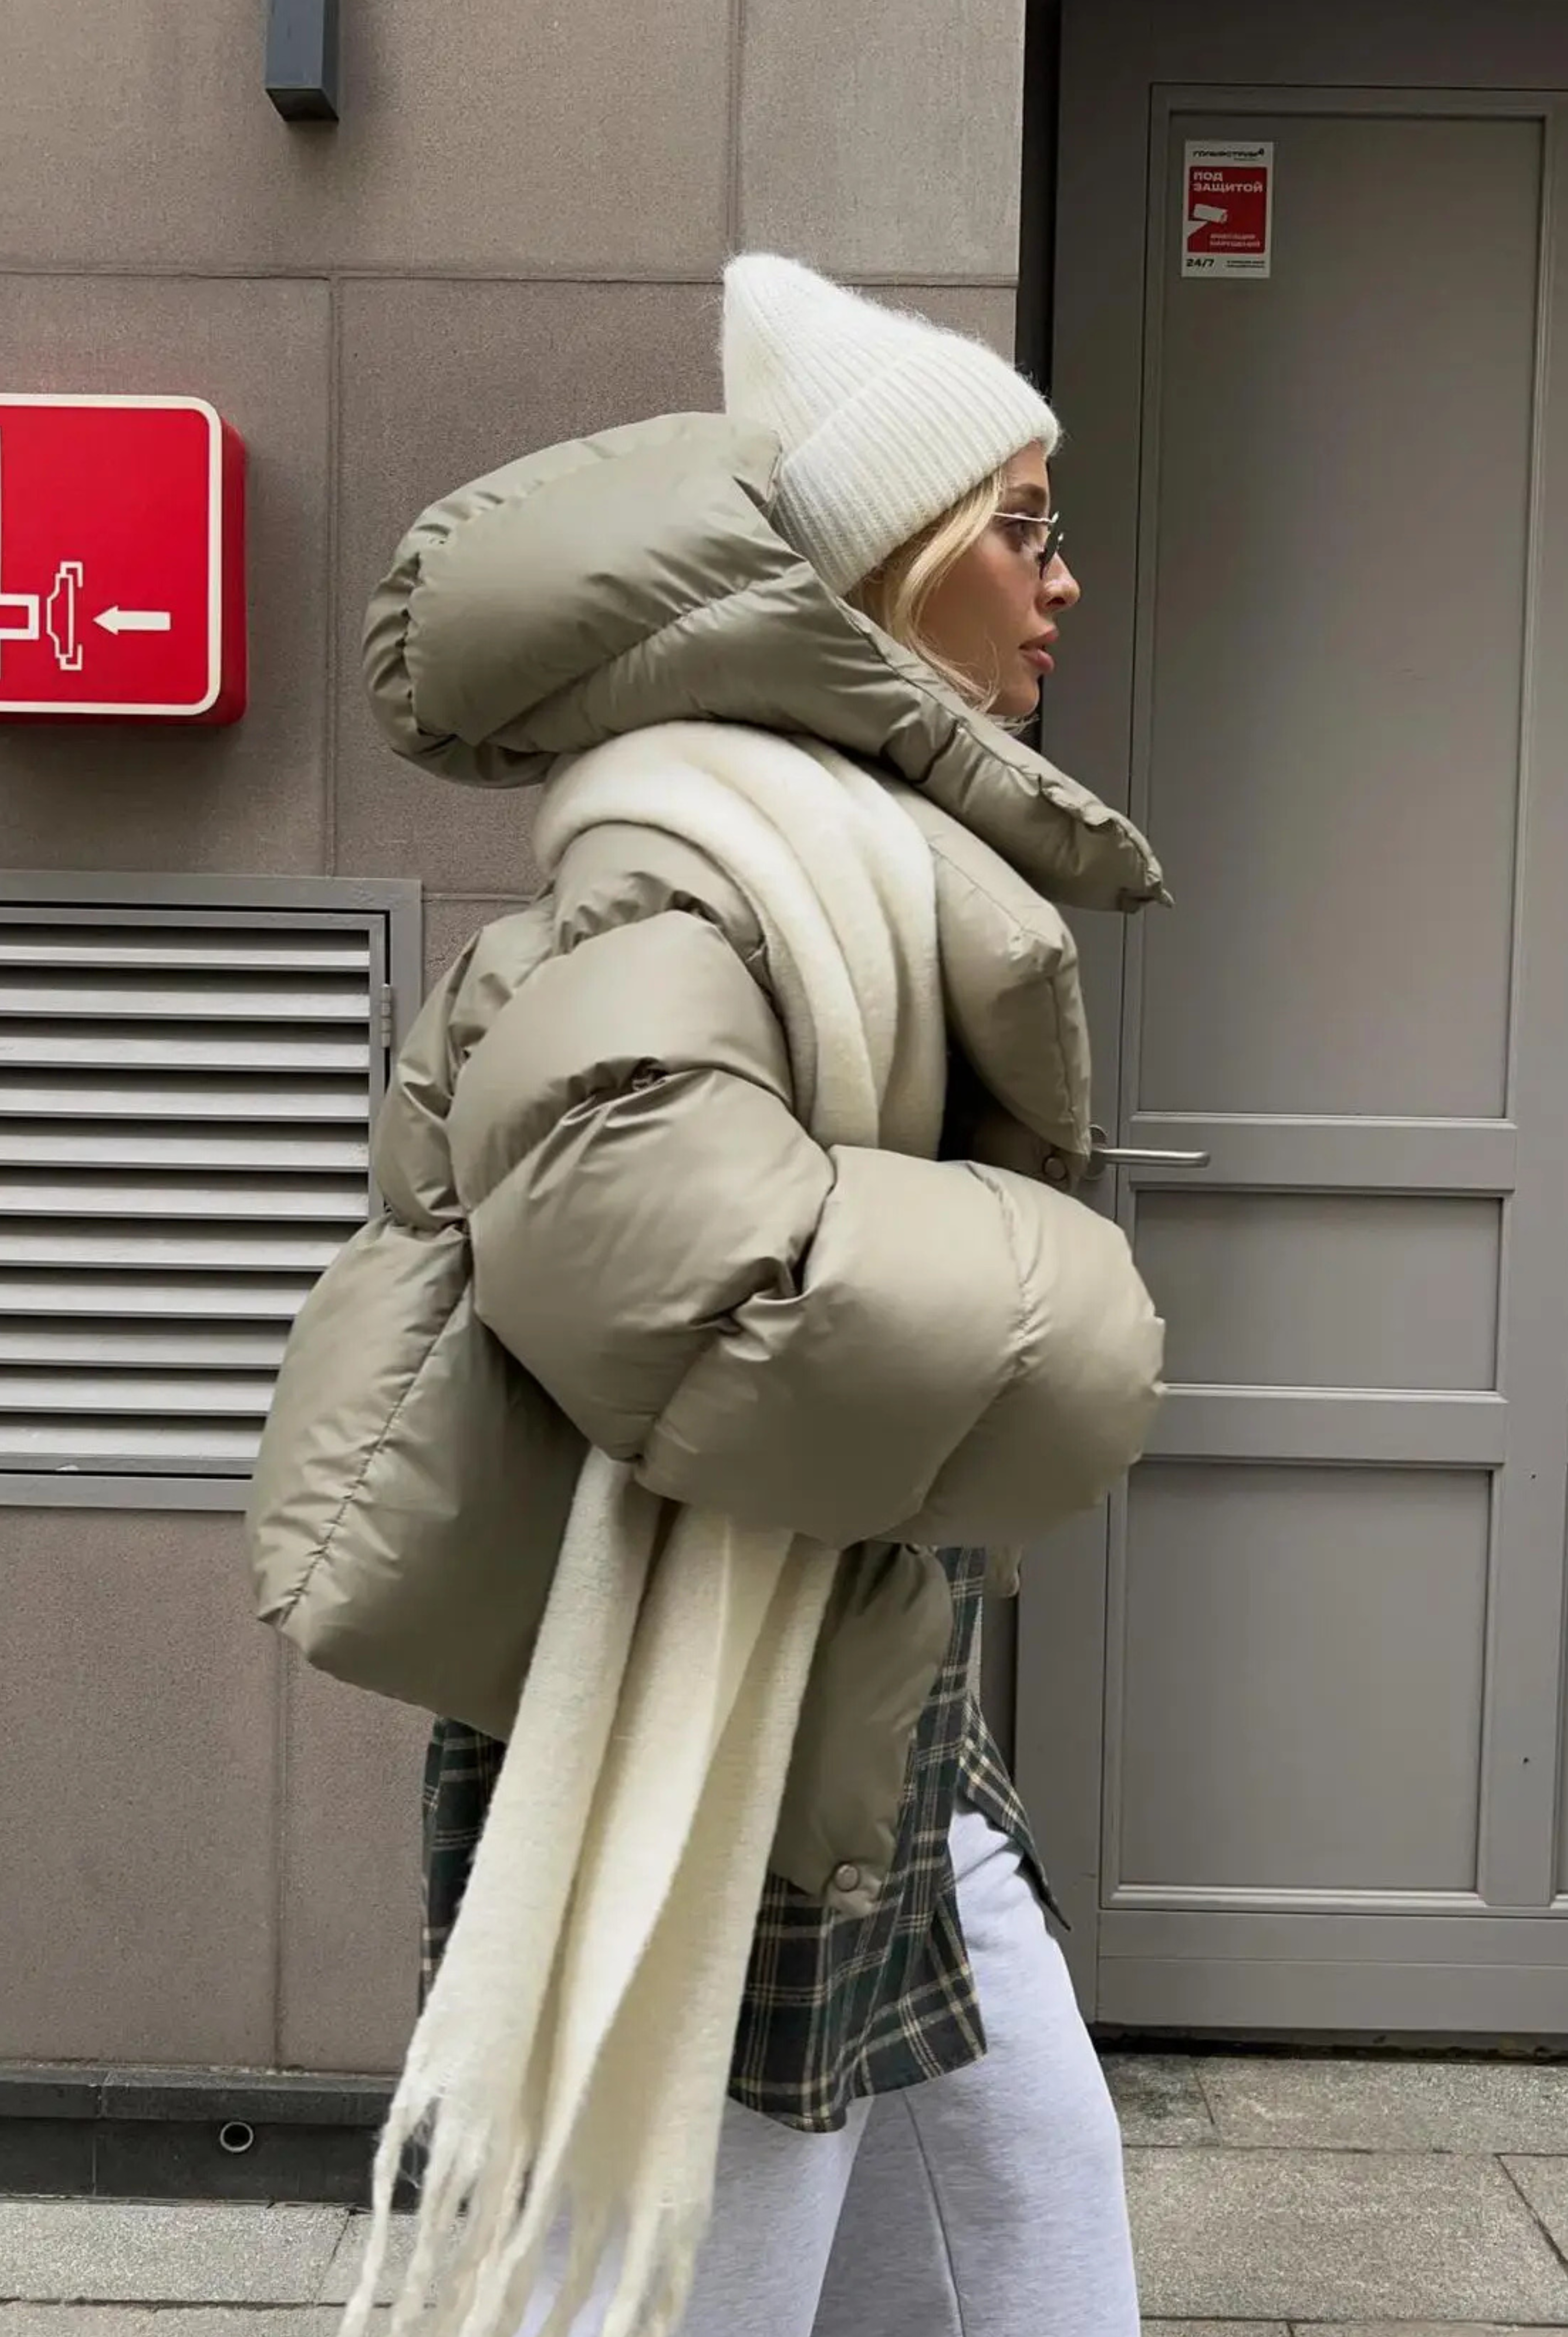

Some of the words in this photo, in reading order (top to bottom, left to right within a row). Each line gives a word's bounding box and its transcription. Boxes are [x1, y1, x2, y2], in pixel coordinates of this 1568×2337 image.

[1194, 172, 1223, 181] ПОД
[1194, 182, 1263, 192] ЗАЩИТОЙ
[1186, 259, 1214, 267] 24/7
